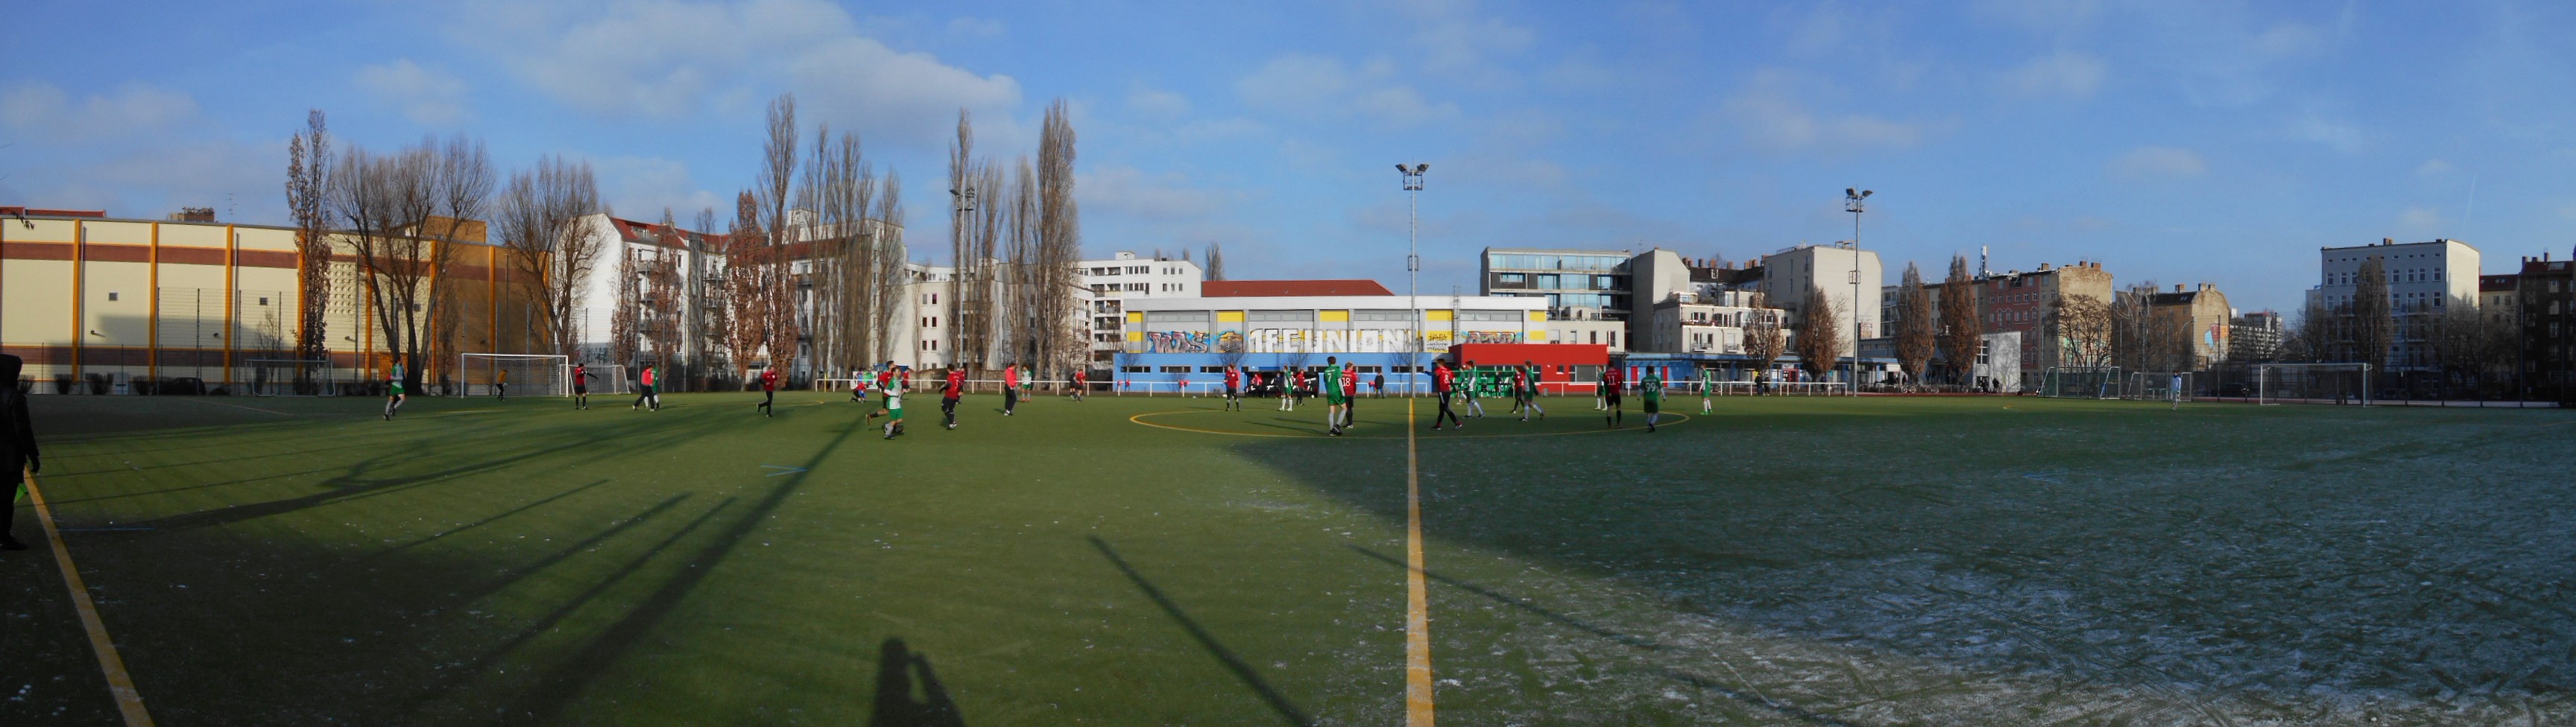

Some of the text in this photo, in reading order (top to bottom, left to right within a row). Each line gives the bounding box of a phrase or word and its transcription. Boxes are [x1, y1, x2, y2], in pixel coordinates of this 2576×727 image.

[1328, 372, 1332, 383] 7
[1342, 377, 1351, 387] 18
[1607, 375, 1616, 386] 11
[1645, 382, 1656, 393] 99
